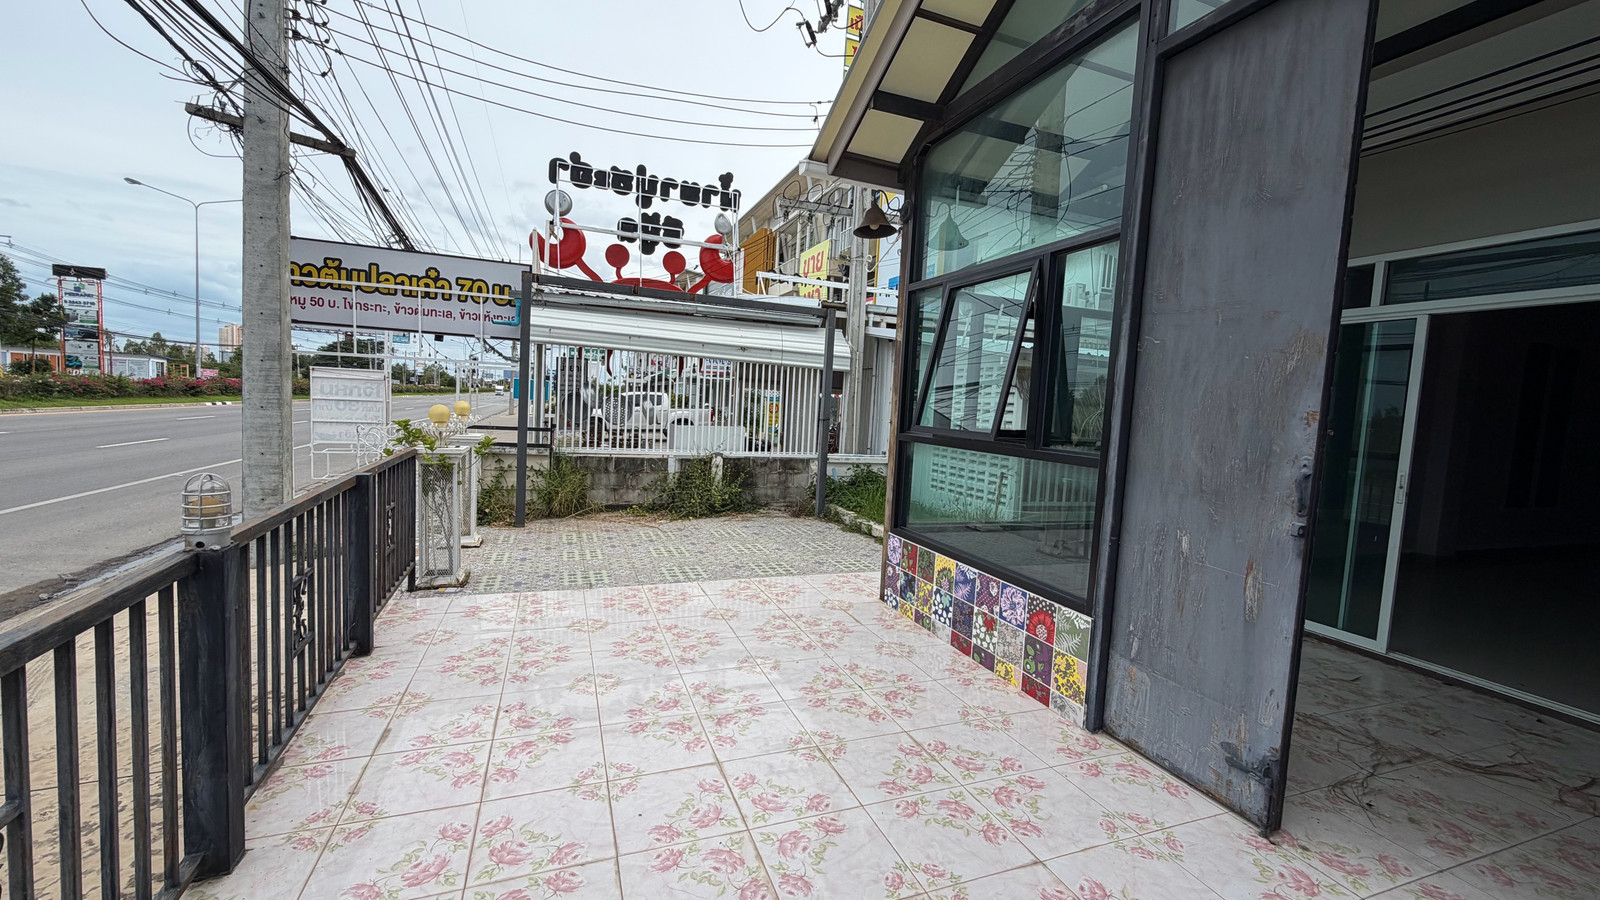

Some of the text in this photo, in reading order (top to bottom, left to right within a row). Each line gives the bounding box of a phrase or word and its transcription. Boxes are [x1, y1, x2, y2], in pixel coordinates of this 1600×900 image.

[290, 257, 452, 301] าวต้มปลาเก๋า
[456, 277, 490, 304] 70
[310, 296, 325, 307] 50
[328, 299, 340, 309] บ.
